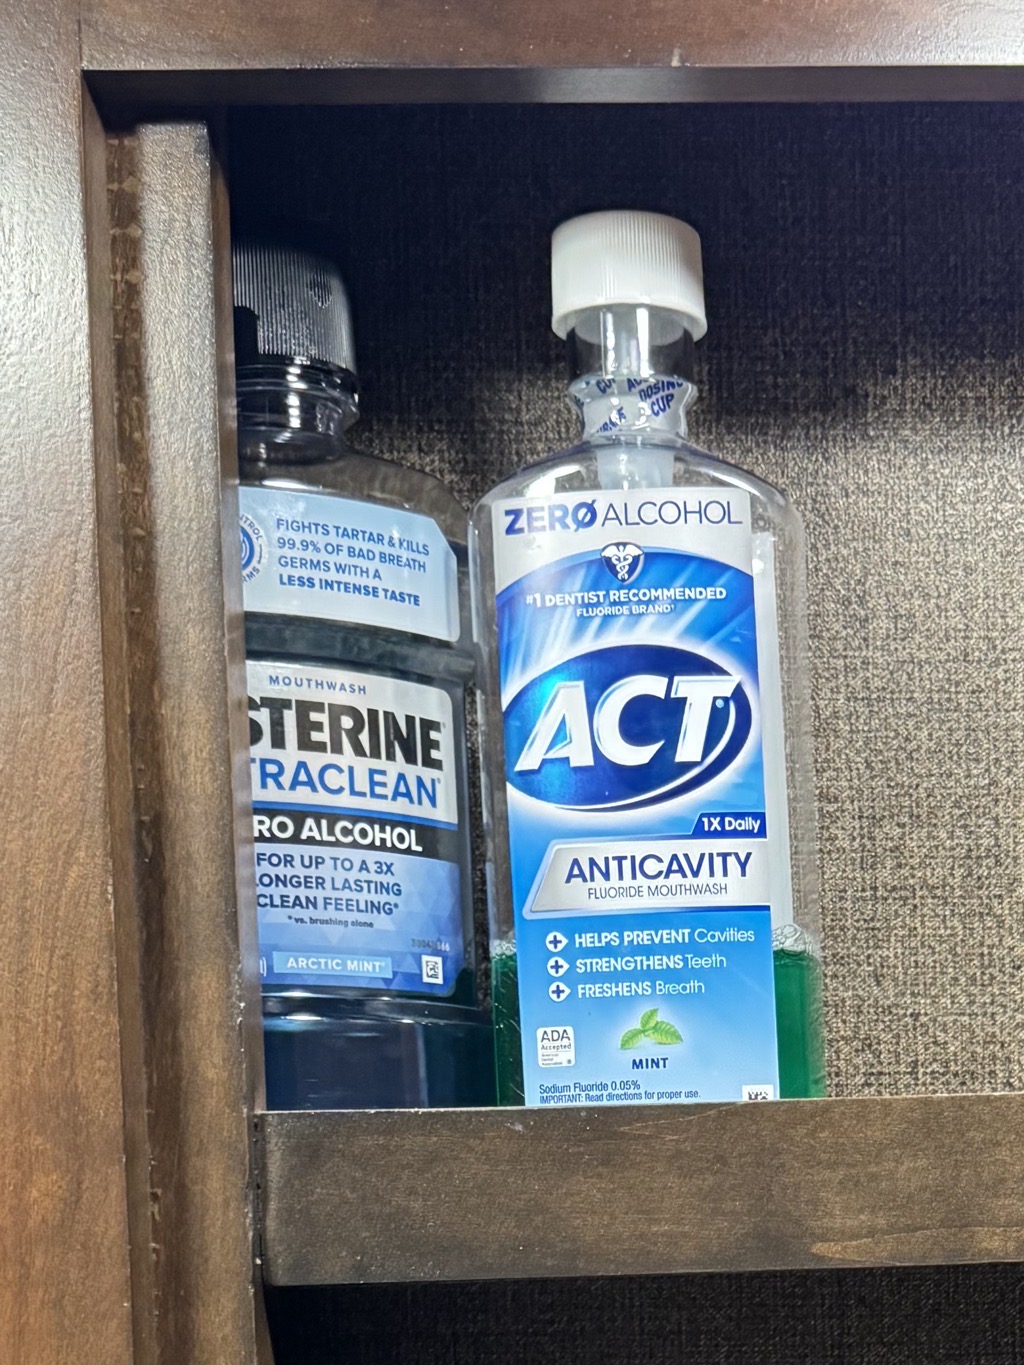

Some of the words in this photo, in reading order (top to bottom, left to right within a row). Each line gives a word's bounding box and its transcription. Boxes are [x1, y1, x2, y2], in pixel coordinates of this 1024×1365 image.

[650, 393, 675, 417] CUP
[601, 500, 743, 527] ALCOHOL
[276, 518, 330, 537] FIGHTS
[333, 525, 385, 547] TARTAR
[387, 536, 397, 548] &
[399, 538, 430, 556] KILLS
[277, 537, 322, 554] 99.9%
[324, 542, 344, 556] OF
[348, 546, 376, 562] BAD
[379, 552, 427, 574] BREATH
[278, 555, 331, 572] GERMS
[334, 562, 370, 580] WITH
[372, 568, 383, 581] A
[279, 573, 316, 590] LESS
[319, 578, 380, 598] INTENSE
[382, 588, 421, 607] TASTE
[525, 592, 541, 608] #1
[545, 591, 606, 607] DENTIST
[609, 587, 727, 602] RECOMMENDED
[577, 605, 630, 618] FLUORIDE
[268, 674, 367, 696] MOUTHWASH
[514, 674, 743, 772] ACT
[250, 757, 438, 809] RACLEAN
[300, 817, 423, 852] ALCOHOL
[701, 816, 721, 832] 1X
[724, 816, 761, 834] Daily
[256, 852, 295, 869] FOR
[300, 855, 326, 872] UP
[329, 857, 354, 873] TO
[358, 859, 371, 874] A
[374, 860, 395, 877] 3X
[564, 852, 753, 885] ANTICAVITY
[255, 873, 326, 892] ONGER
[331, 875, 402, 897] LASTING
[587, 886, 644, 900] FLUORIDE
[647, 883, 728, 897] MOUTHWASH
[257, 893, 318, 911] CLEAN
[309, 916, 349, 929] brushing
[351, 919, 374, 929] alone
[575, 931, 620, 949] HELPS
[623, 929, 691, 946] PREVENT
[694, 927, 755, 944] Cavities
[287, 957, 343, 971] ARCTIC
[347, 960, 382, 974] MINT
[576, 955, 683, 974] STRENGTHENS
[685, 953, 727, 969] Teeth
[577, 981, 652, 999] FRESHENS
[655, 979, 705, 996] Breath
[540, 1029, 571, 1043] ADA
[541, 1042, 572, 1052] Accepted
[631, 1057, 669, 1070] MINT
[539, 1083, 571, 1095] Sodium
[574, 1081, 609, 1093] Fluoride
[611, 1080, 641, 1092] 0.05%
[539, 1094, 584, 1105] IMPORTANT:
[585, 1093, 604, 1103] Read
[606, 1091, 643, 1102] directions
[644, 1090, 655, 1100] for
[657, 1091, 683, 1101] proper
[684, 1090, 701, 1099] use.
